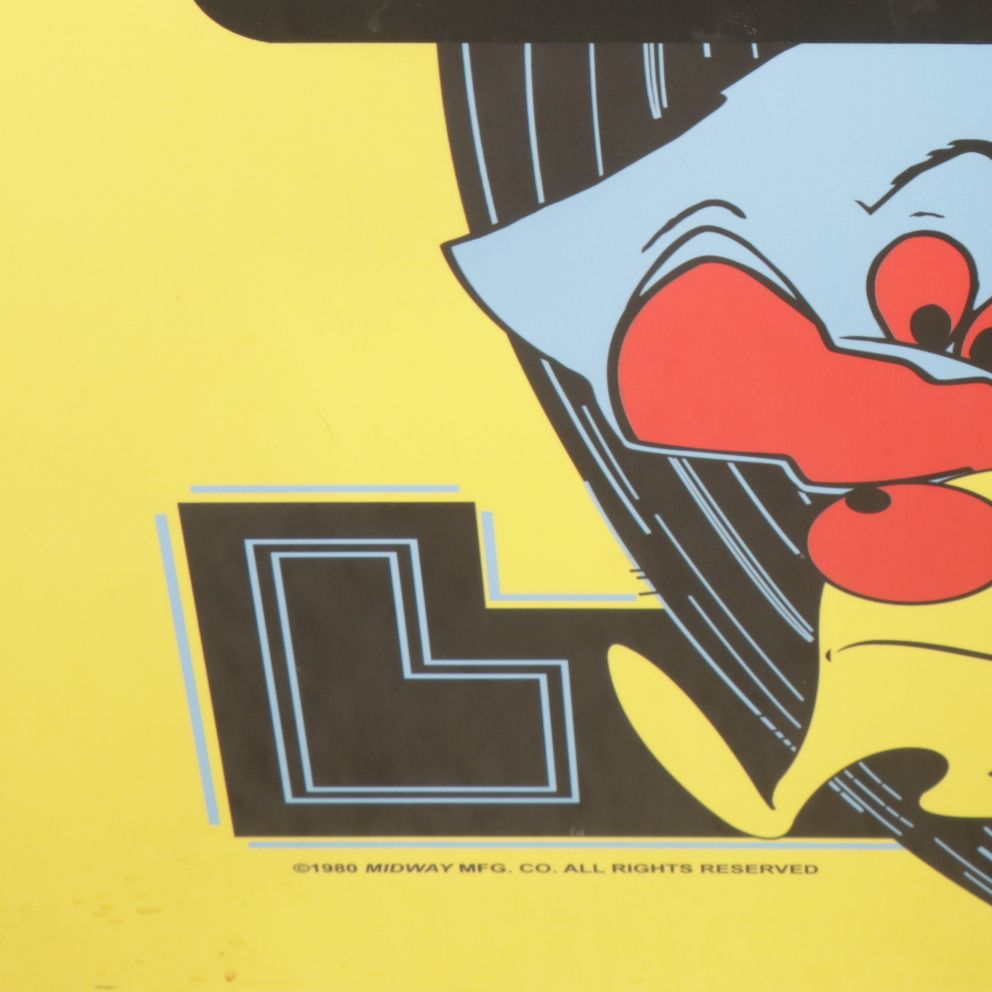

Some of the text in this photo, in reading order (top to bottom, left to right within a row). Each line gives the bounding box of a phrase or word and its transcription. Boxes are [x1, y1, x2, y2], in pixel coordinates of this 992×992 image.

[292, 863, 819, 875] ©1980 MIDWAY MFG. CO. ALL RIGHTS RESERVED
